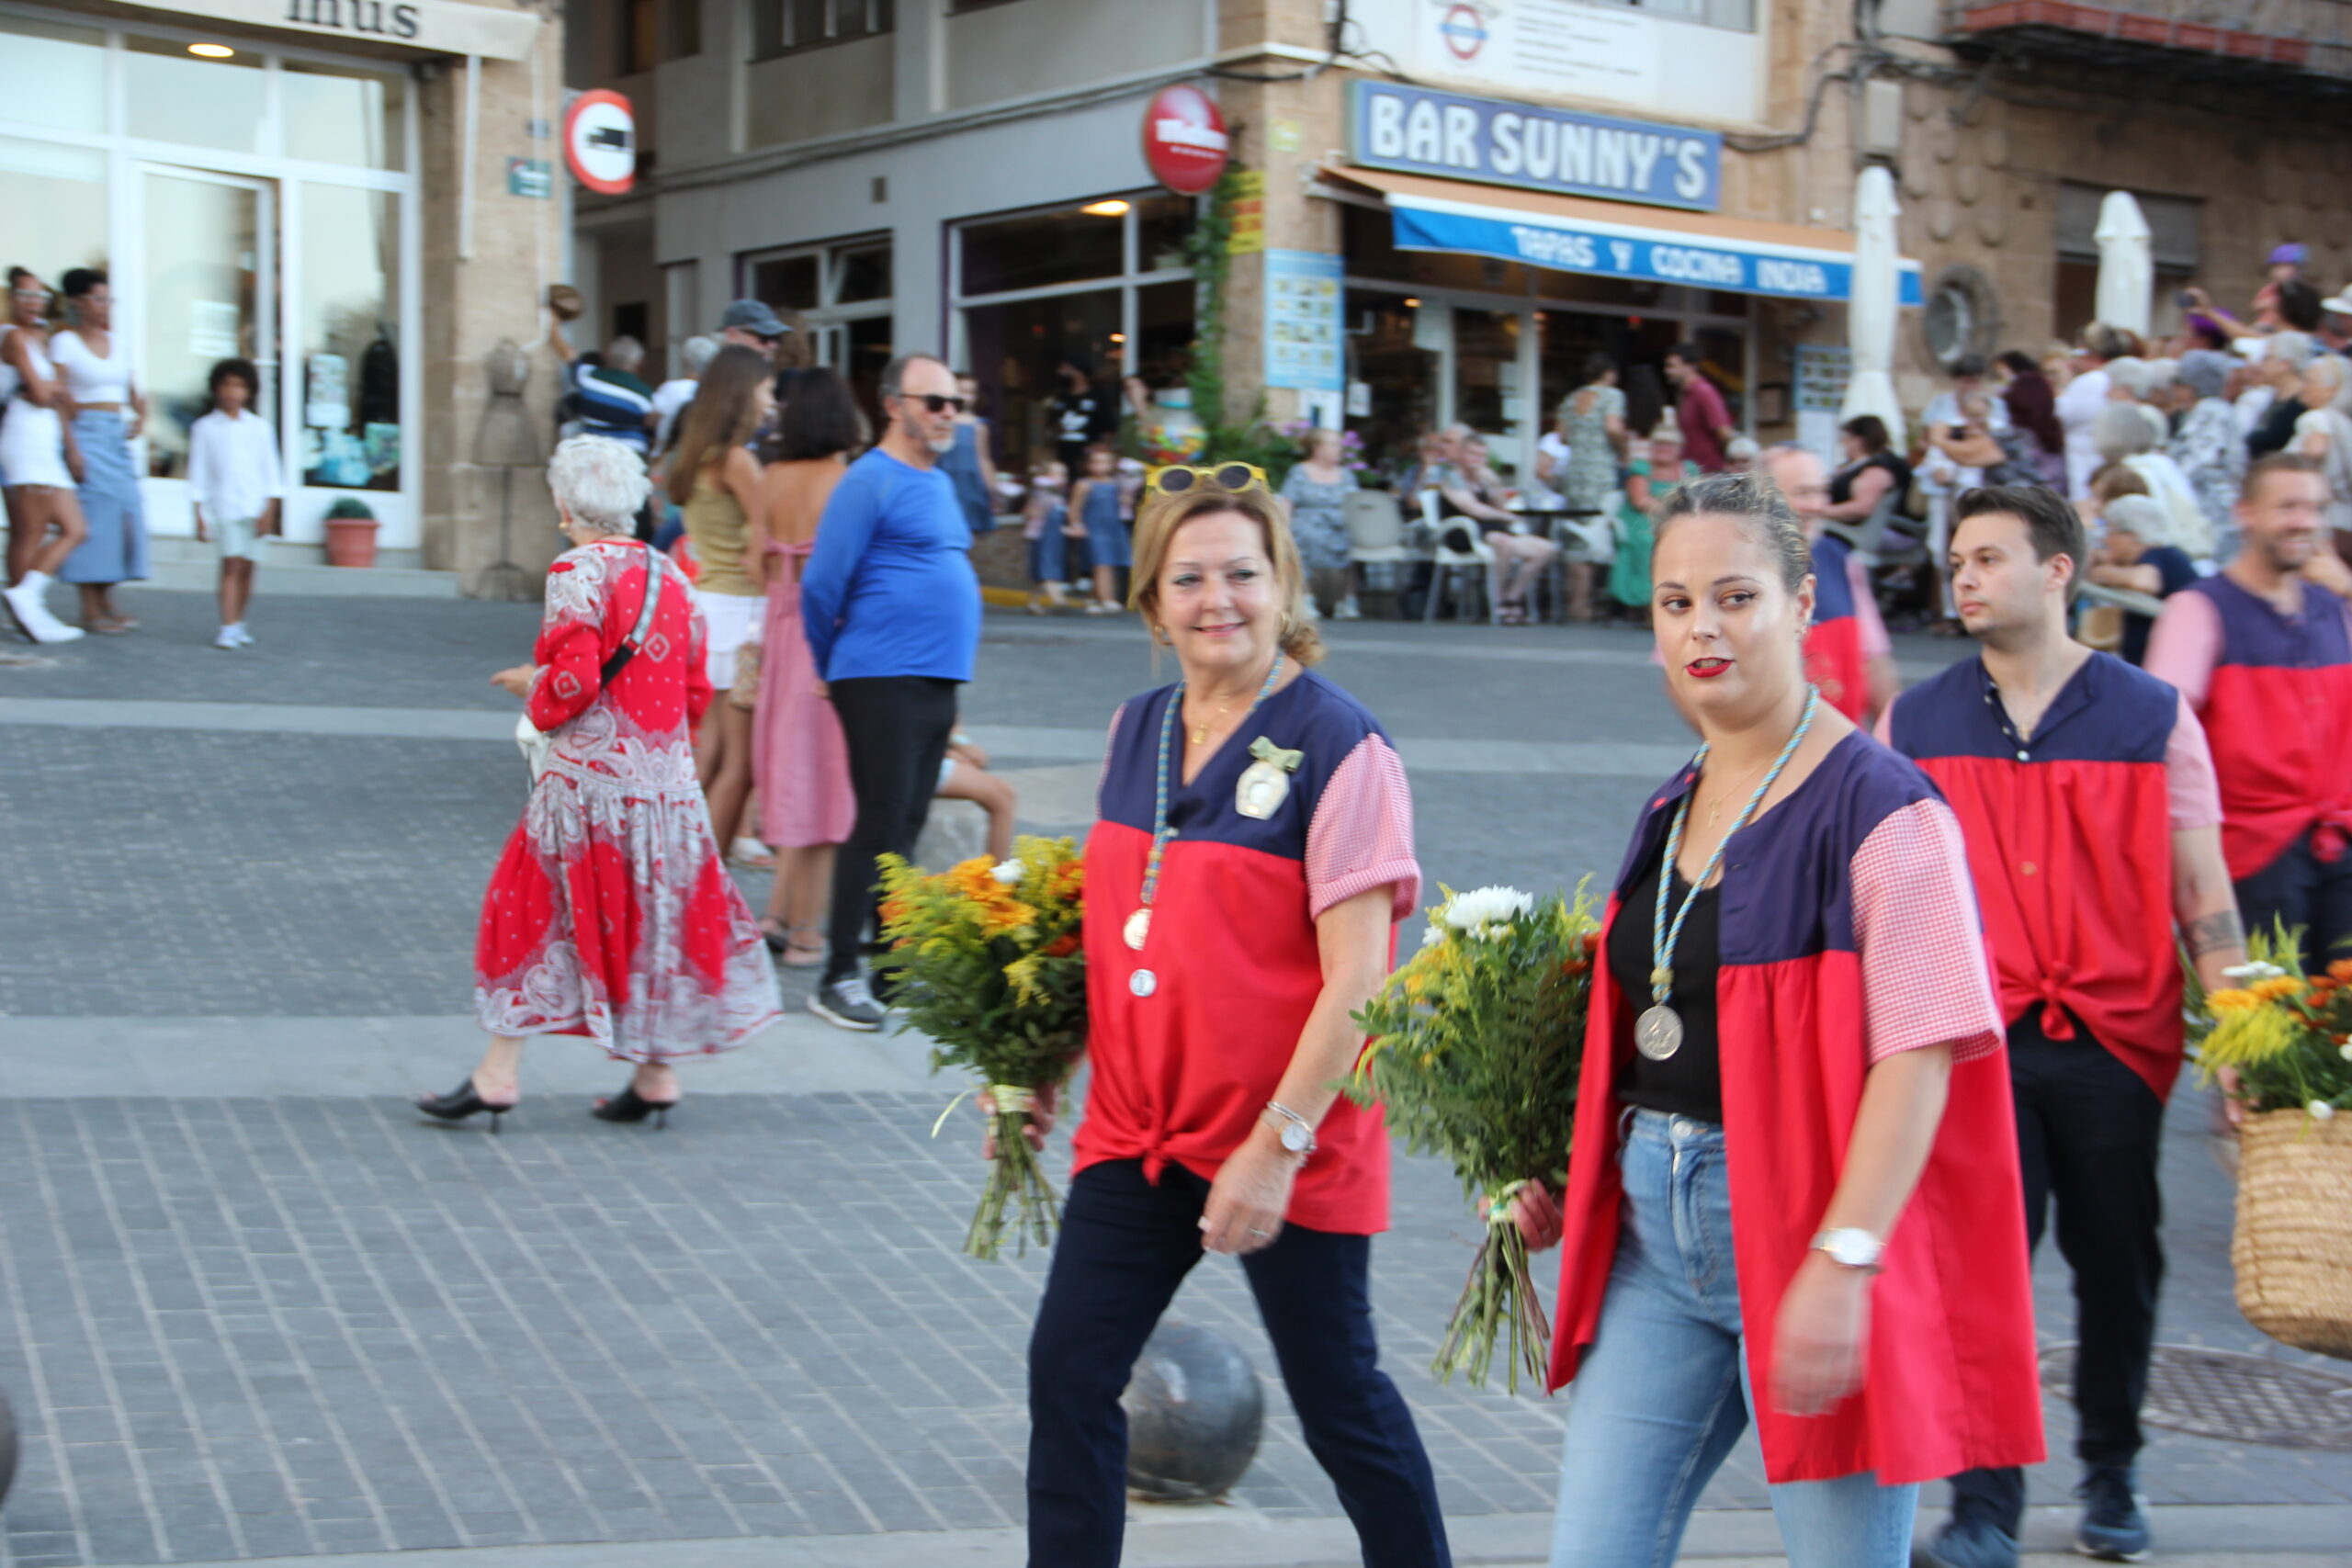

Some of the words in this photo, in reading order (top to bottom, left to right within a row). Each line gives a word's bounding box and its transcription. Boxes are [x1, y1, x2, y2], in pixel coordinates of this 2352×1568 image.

[1369, 94, 1481, 170] BAR
[1488, 111, 1708, 201] SUNNY'S
[1510, 225, 1597, 268] TAPAS
[1610, 240, 1634, 272] Y
[1650, 245, 1744, 286] COCINA
[1756, 258, 1828, 294] INDIA
